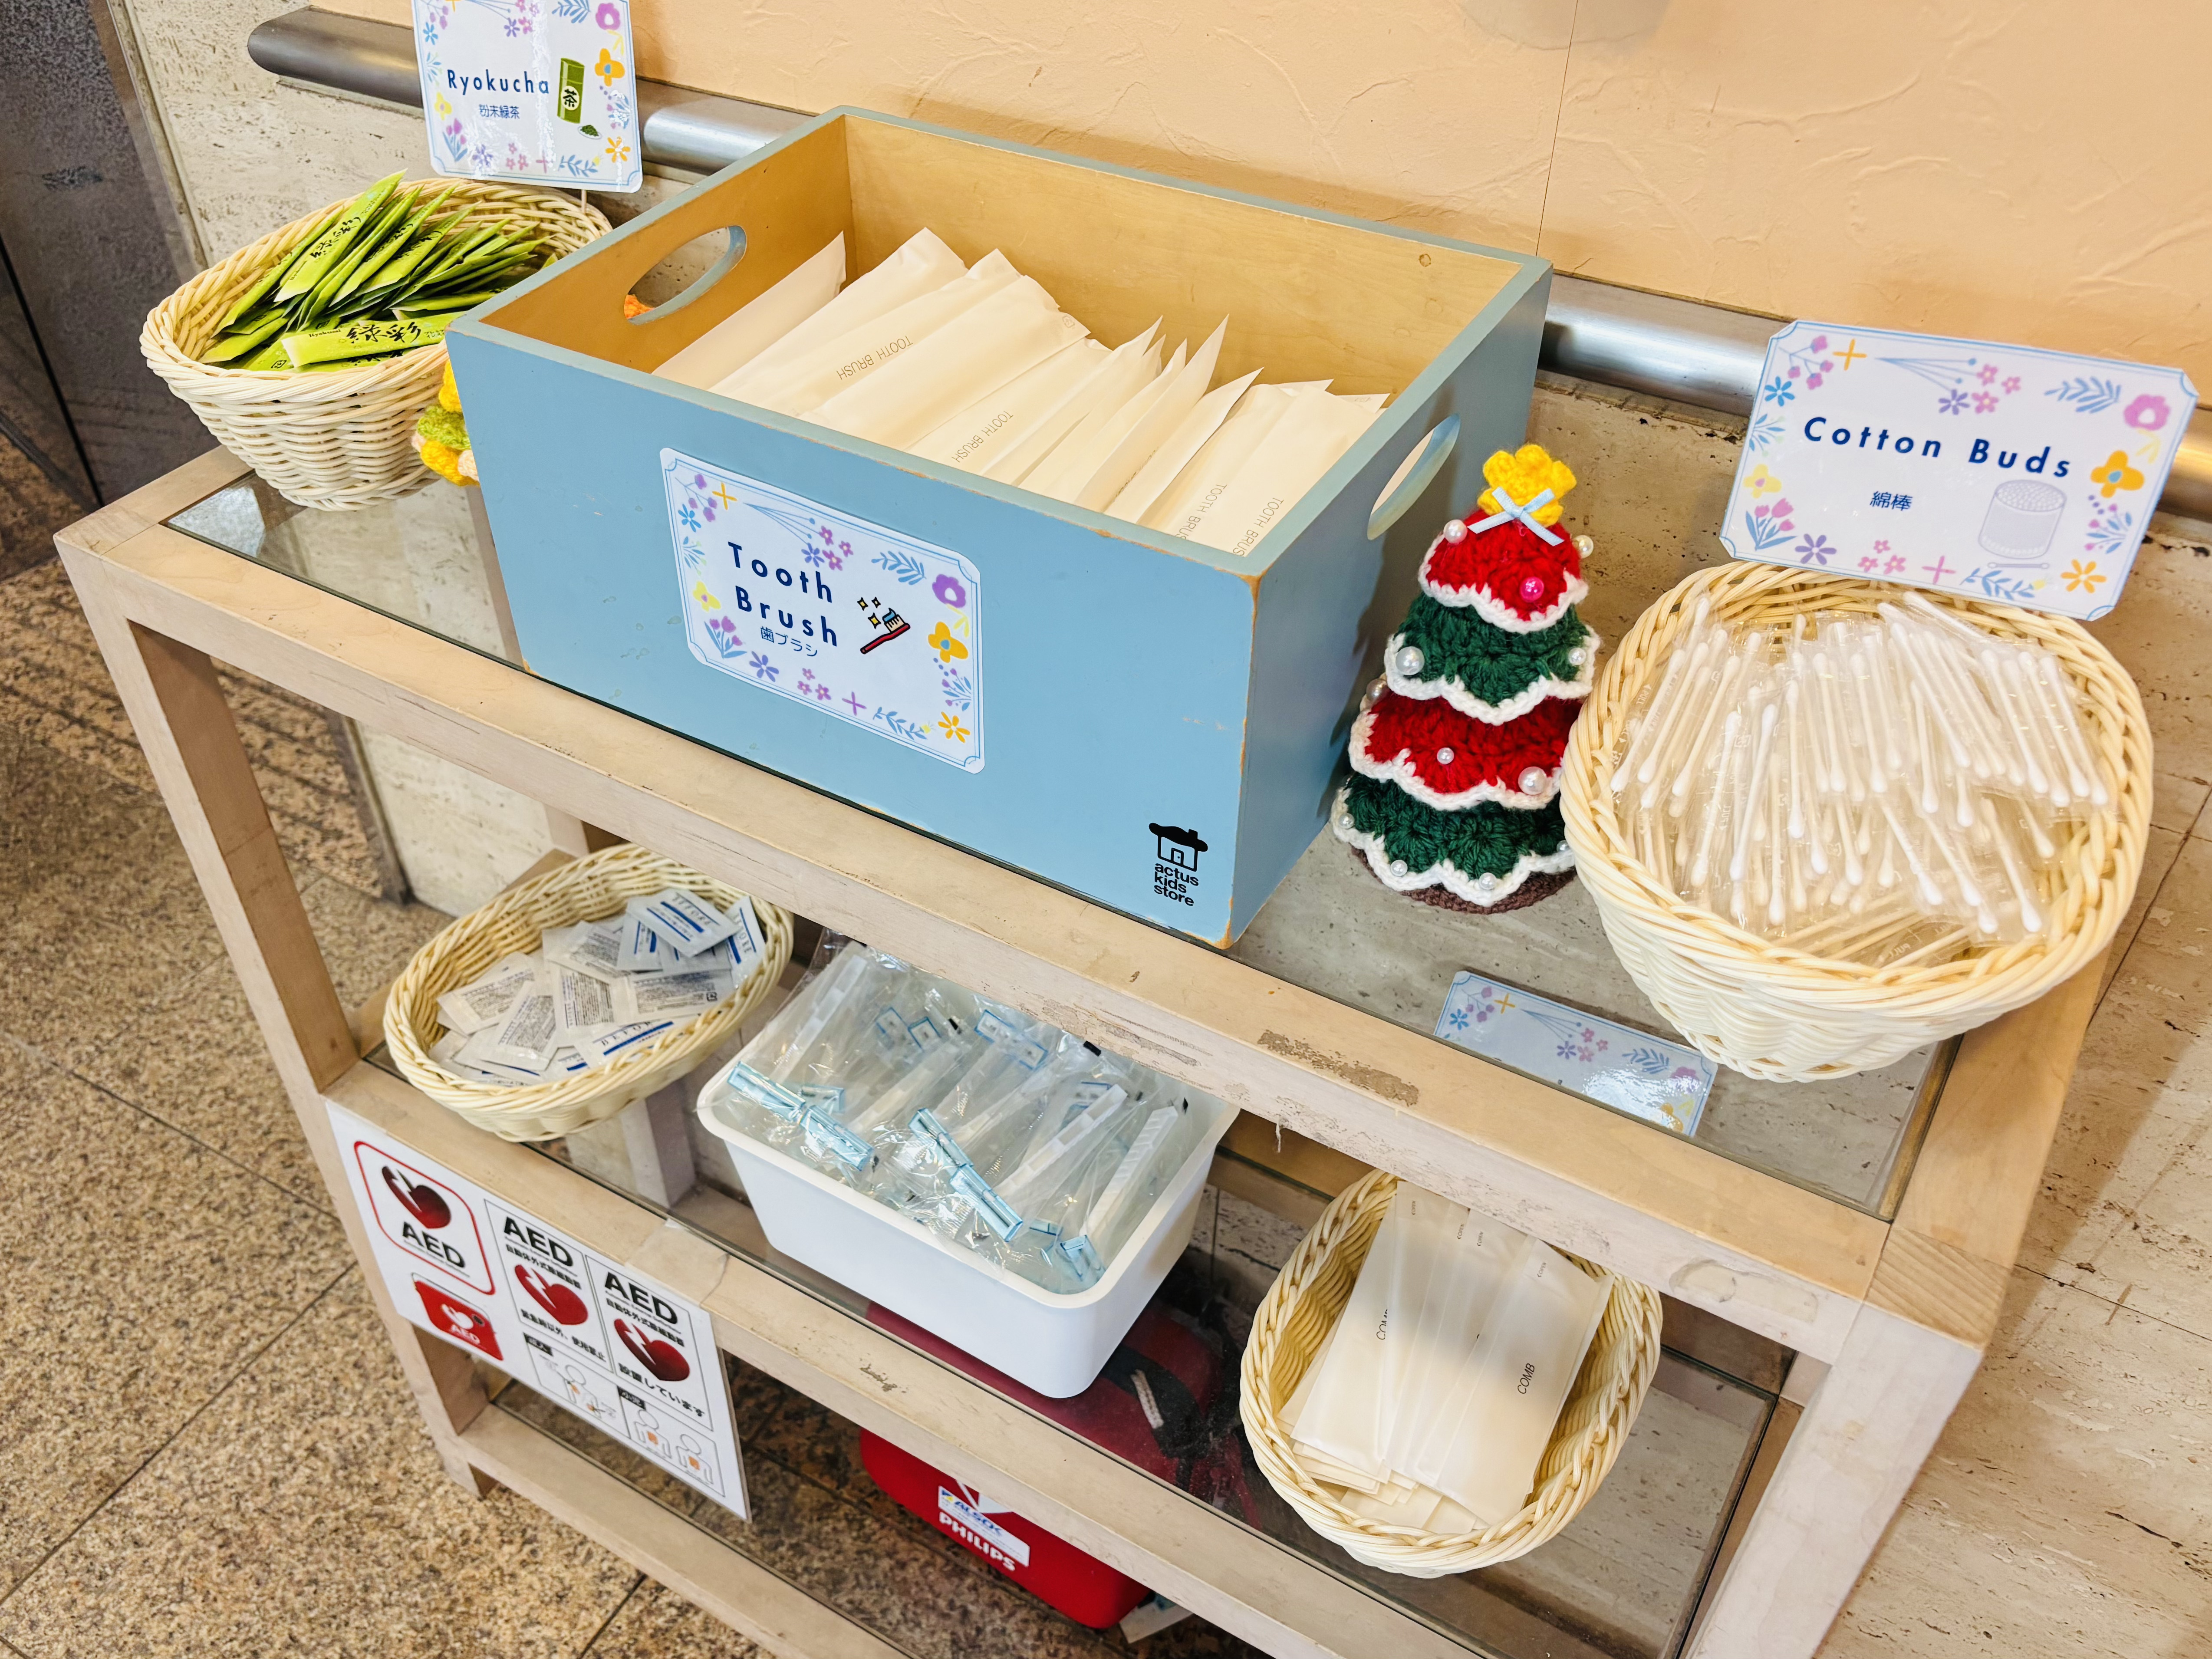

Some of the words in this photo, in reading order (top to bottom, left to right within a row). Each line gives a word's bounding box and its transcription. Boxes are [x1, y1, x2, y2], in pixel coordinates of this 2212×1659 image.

[447, 69, 549, 95] Ryokucha
[563, 88, 577, 108] 茶
[479, 104, 520, 119] 粉末緑茶
[876, 336, 913, 360] TOOTH
[836, 355, 874, 380] BRUSH
[981, 411, 1014, 436] TOOTH
[951, 435, 984, 463] BRUSH
[1804, 416, 1942, 458] Cotton
[1968, 438, 2072, 478] Buds
[1197, 484, 1227, 513] TOOTH
[1870, 490, 1913, 511] 綿棒
[1254, 497, 1284, 528] TOOTH
[1175, 516, 1201, 540] BRUS
[1233, 529, 1258, 556] BRUS
[727, 541, 833, 604] Tooth
[735, 585, 838, 647] Brush
[760, 625, 818, 657] 歯ブラシ
[1154, 871, 1187, 893] kids
[1155, 863, 1199, 886] actus
[1154, 885, 1194, 906] store
[602, 1021, 651, 1047] BEFOR
[402, 1221, 466, 1268] AED
[504, 1216, 574, 1267] AED
[1538, 1261, 1547, 1275] OPEN
[605, 1271, 678, 1325] AED
[450, 1324, 481, 1345] AED
[618, 1363, 705, 1417] 設置しています
[1517, 1363, 1535, 1394] COMB
[939, 1511, 1016, 1572] PHILIPS
